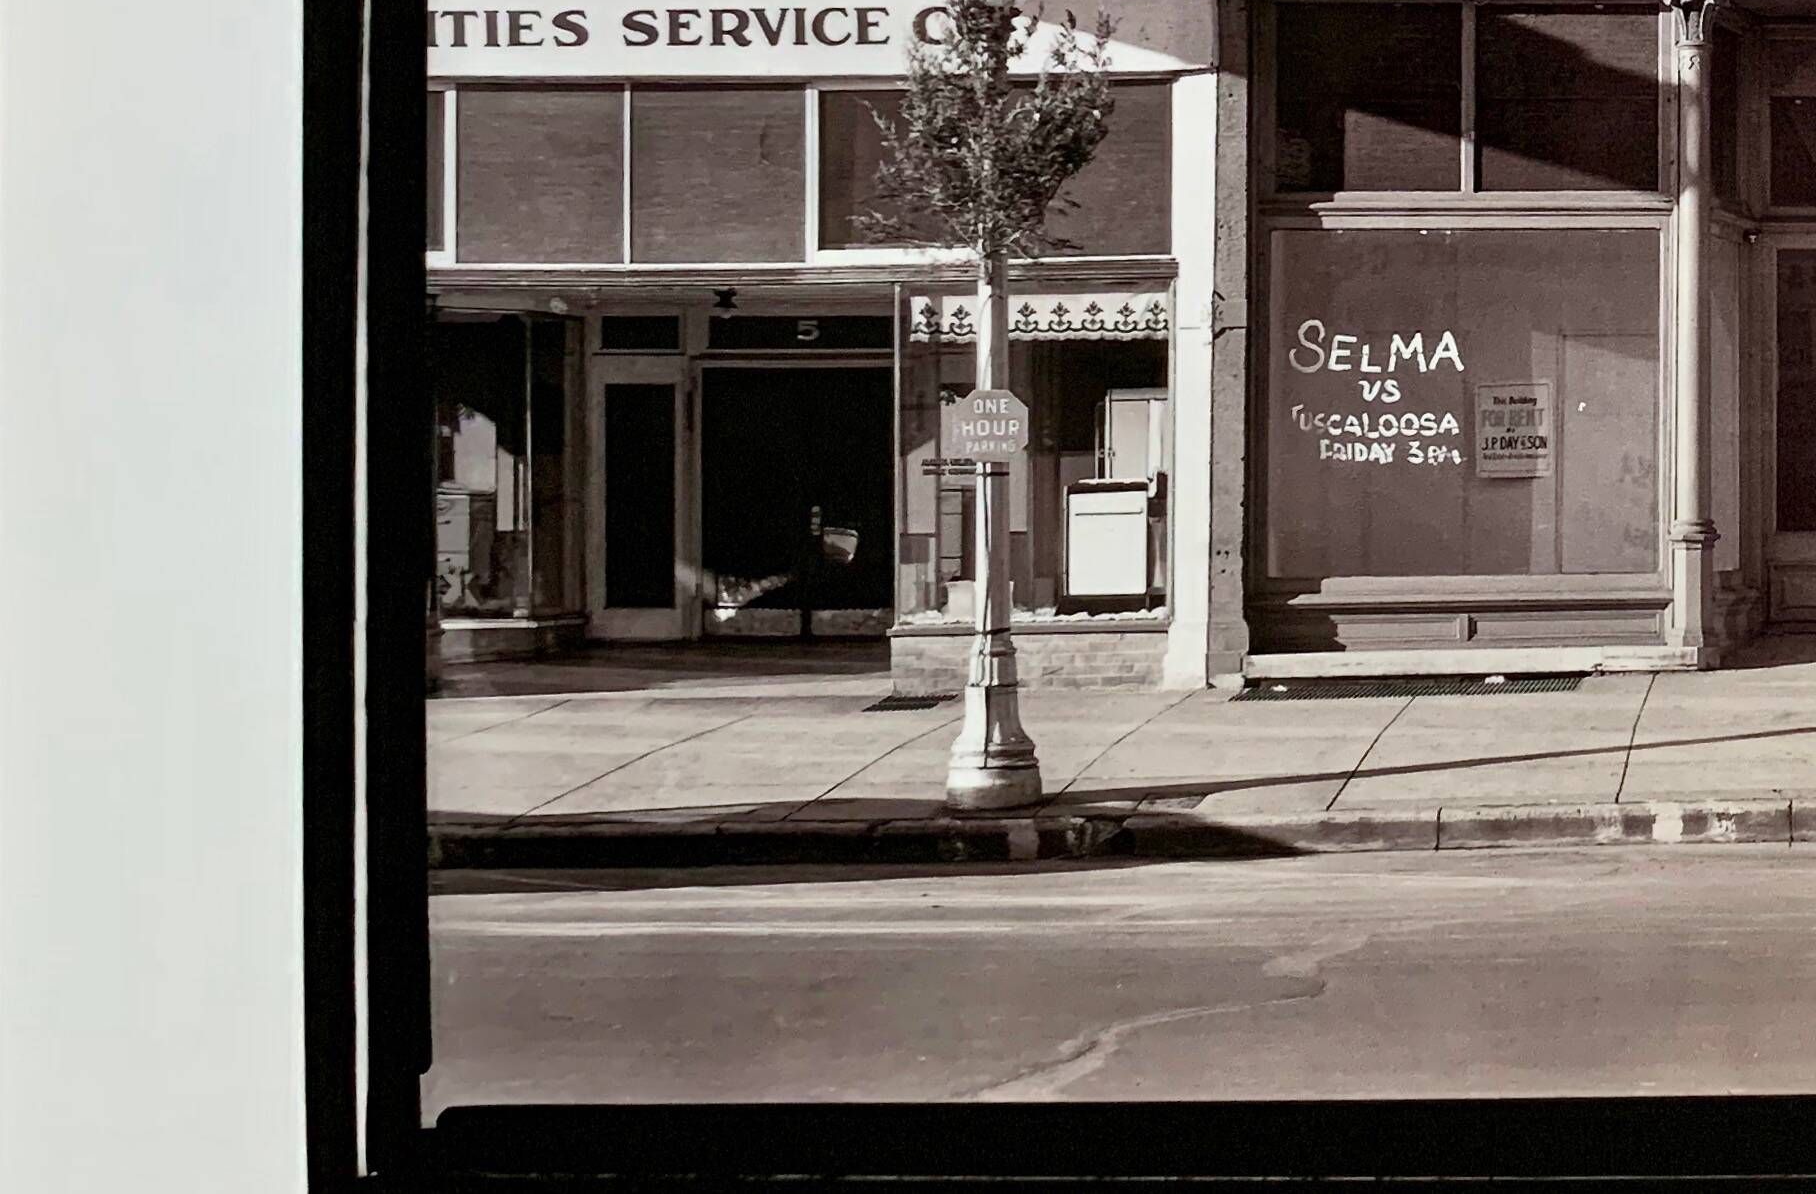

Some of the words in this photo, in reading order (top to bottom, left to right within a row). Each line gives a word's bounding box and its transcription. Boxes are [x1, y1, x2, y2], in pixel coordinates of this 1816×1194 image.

[623, 7, 890, 46] SERVICE
[1288, 318, 1465, 374] SELMA
[973, 398, 1010, 414] ONE
[1481, 410, 1505, 427] FOR
[1509, 408, 1544, 426] RENT
[961, 419, 1020, 436] HOUR
[966, 439, 1017, 454] PARKING
[1500, 436, 1519, 449] DAY
[1528, 435, 1547, 449] SON
[1319, 439, 1395, 465] FRIDAY
[1406, 440, 1425, 464] 3
